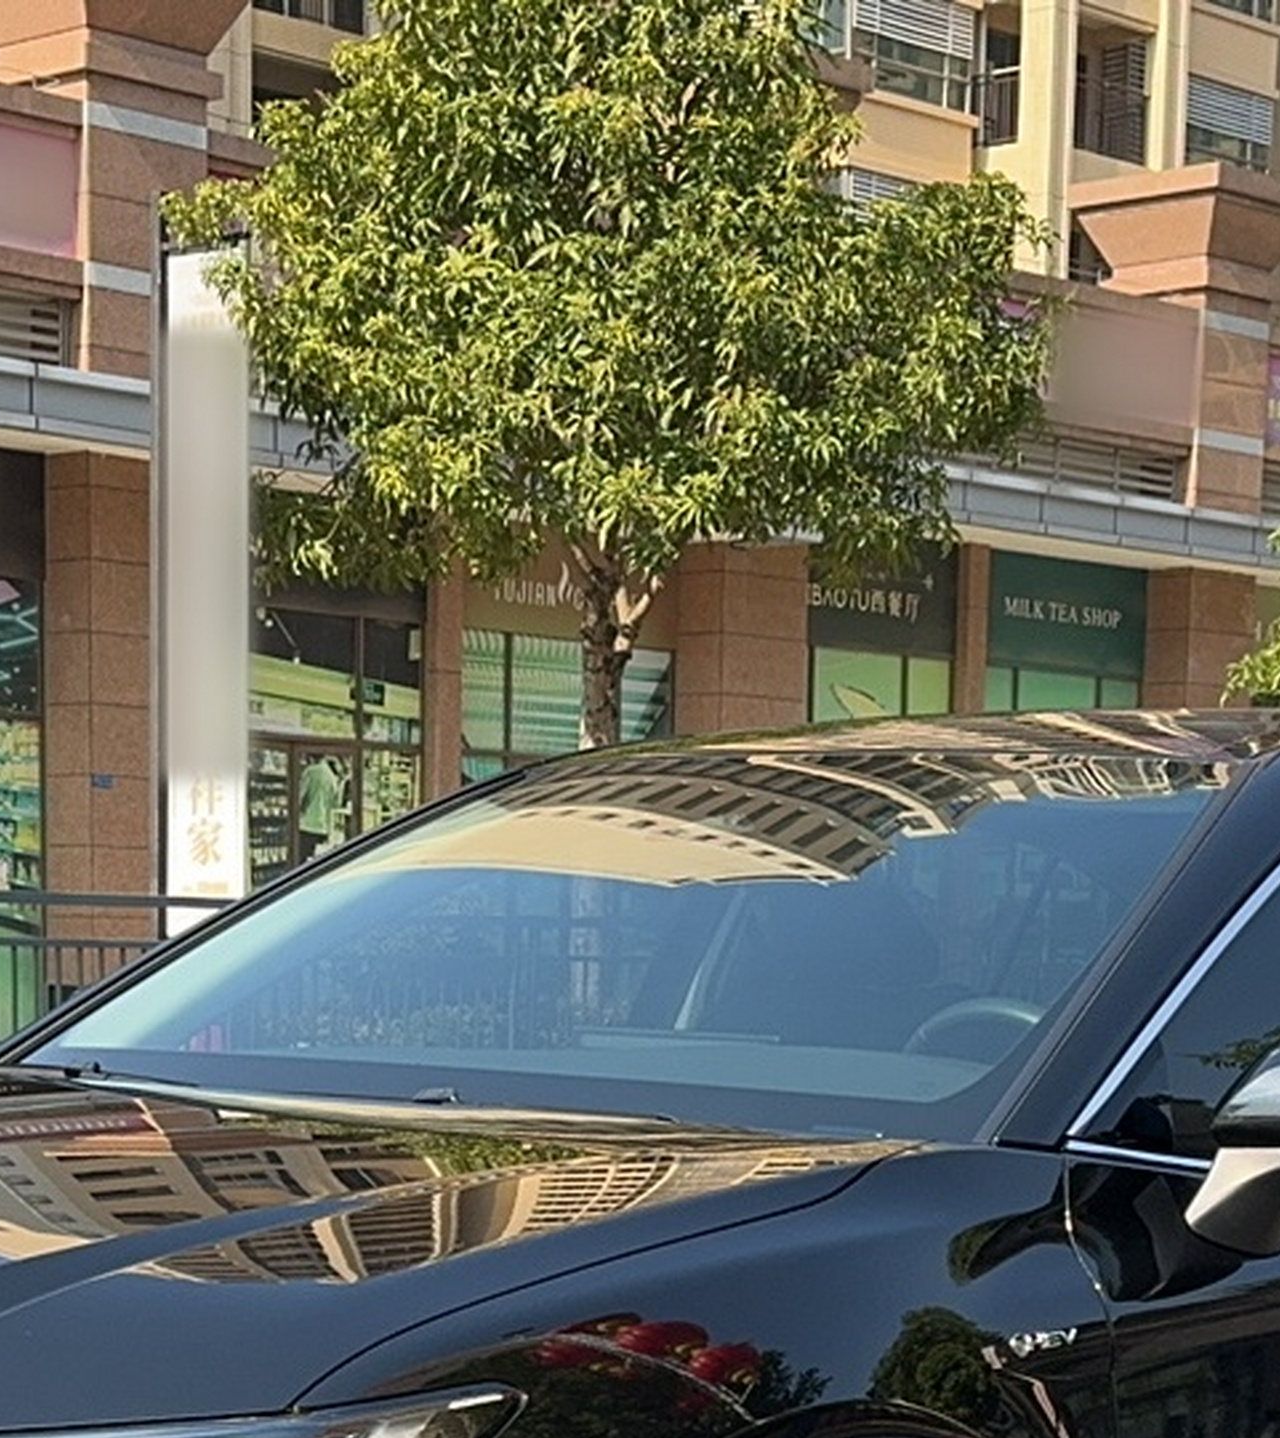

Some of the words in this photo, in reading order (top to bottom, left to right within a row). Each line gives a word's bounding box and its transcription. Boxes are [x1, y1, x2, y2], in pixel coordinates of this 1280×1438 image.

[1004, 596, 1045, 619] MILK
[1048, 601, 1078, 624] TEA
[1082, 606, 1122, 629] SHOP
